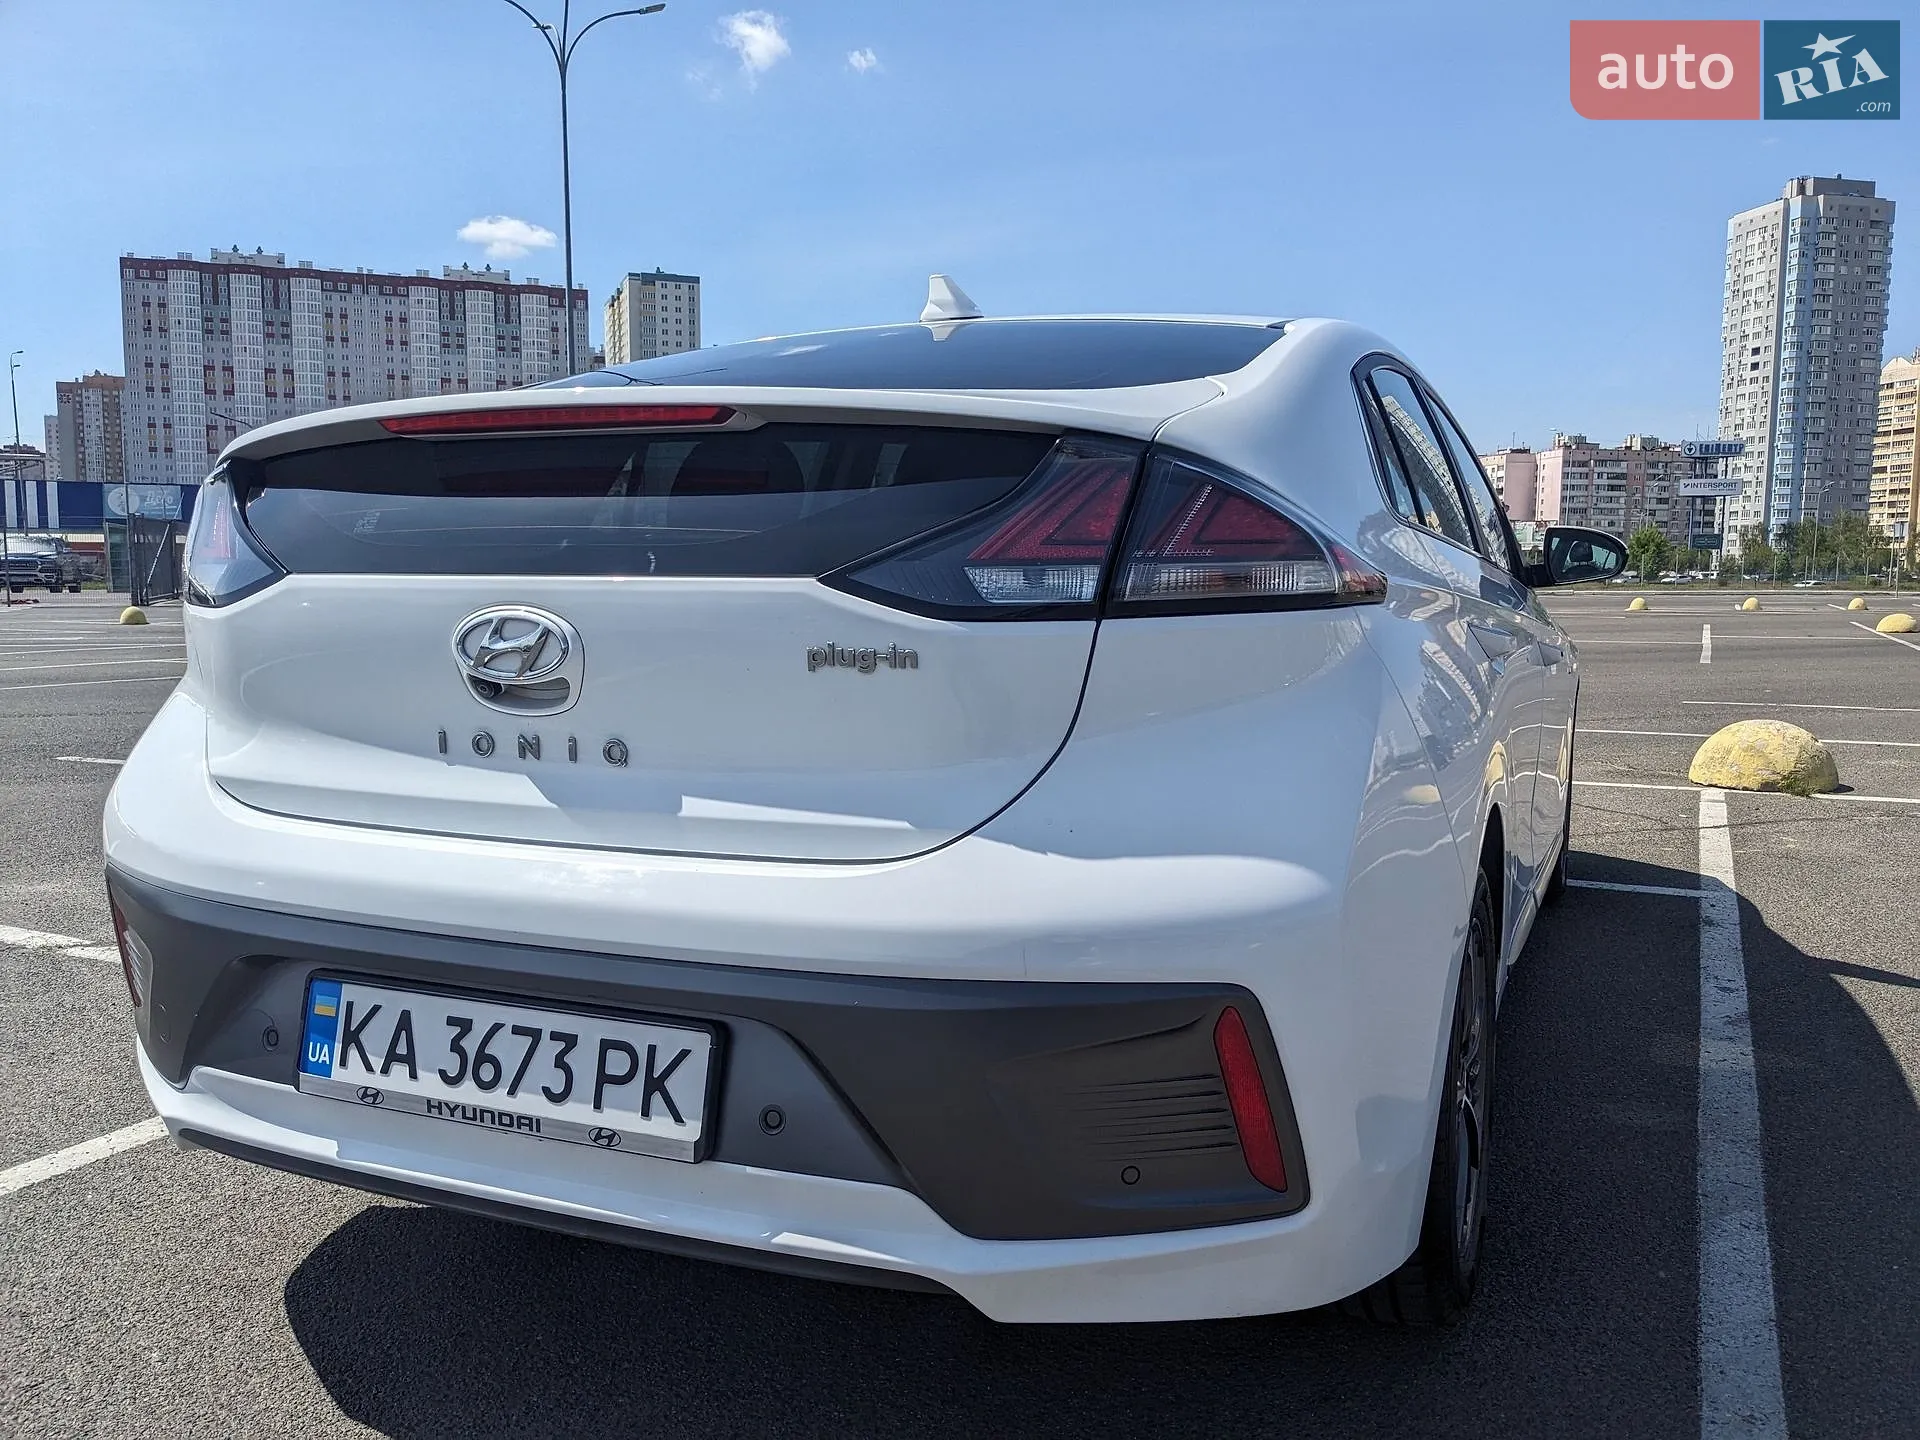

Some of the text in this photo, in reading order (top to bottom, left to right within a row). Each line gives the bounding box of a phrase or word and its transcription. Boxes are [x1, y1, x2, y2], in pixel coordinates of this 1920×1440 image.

[806, 640, 919, 674] plug-in
[437, 728, 630, 768] IONIQ
[308, 1041, 330, 1066] UA
[339, 1000, 693, 1126] KA 3673 PK
[426, 1099, 542, 1134] HYUNDAI
